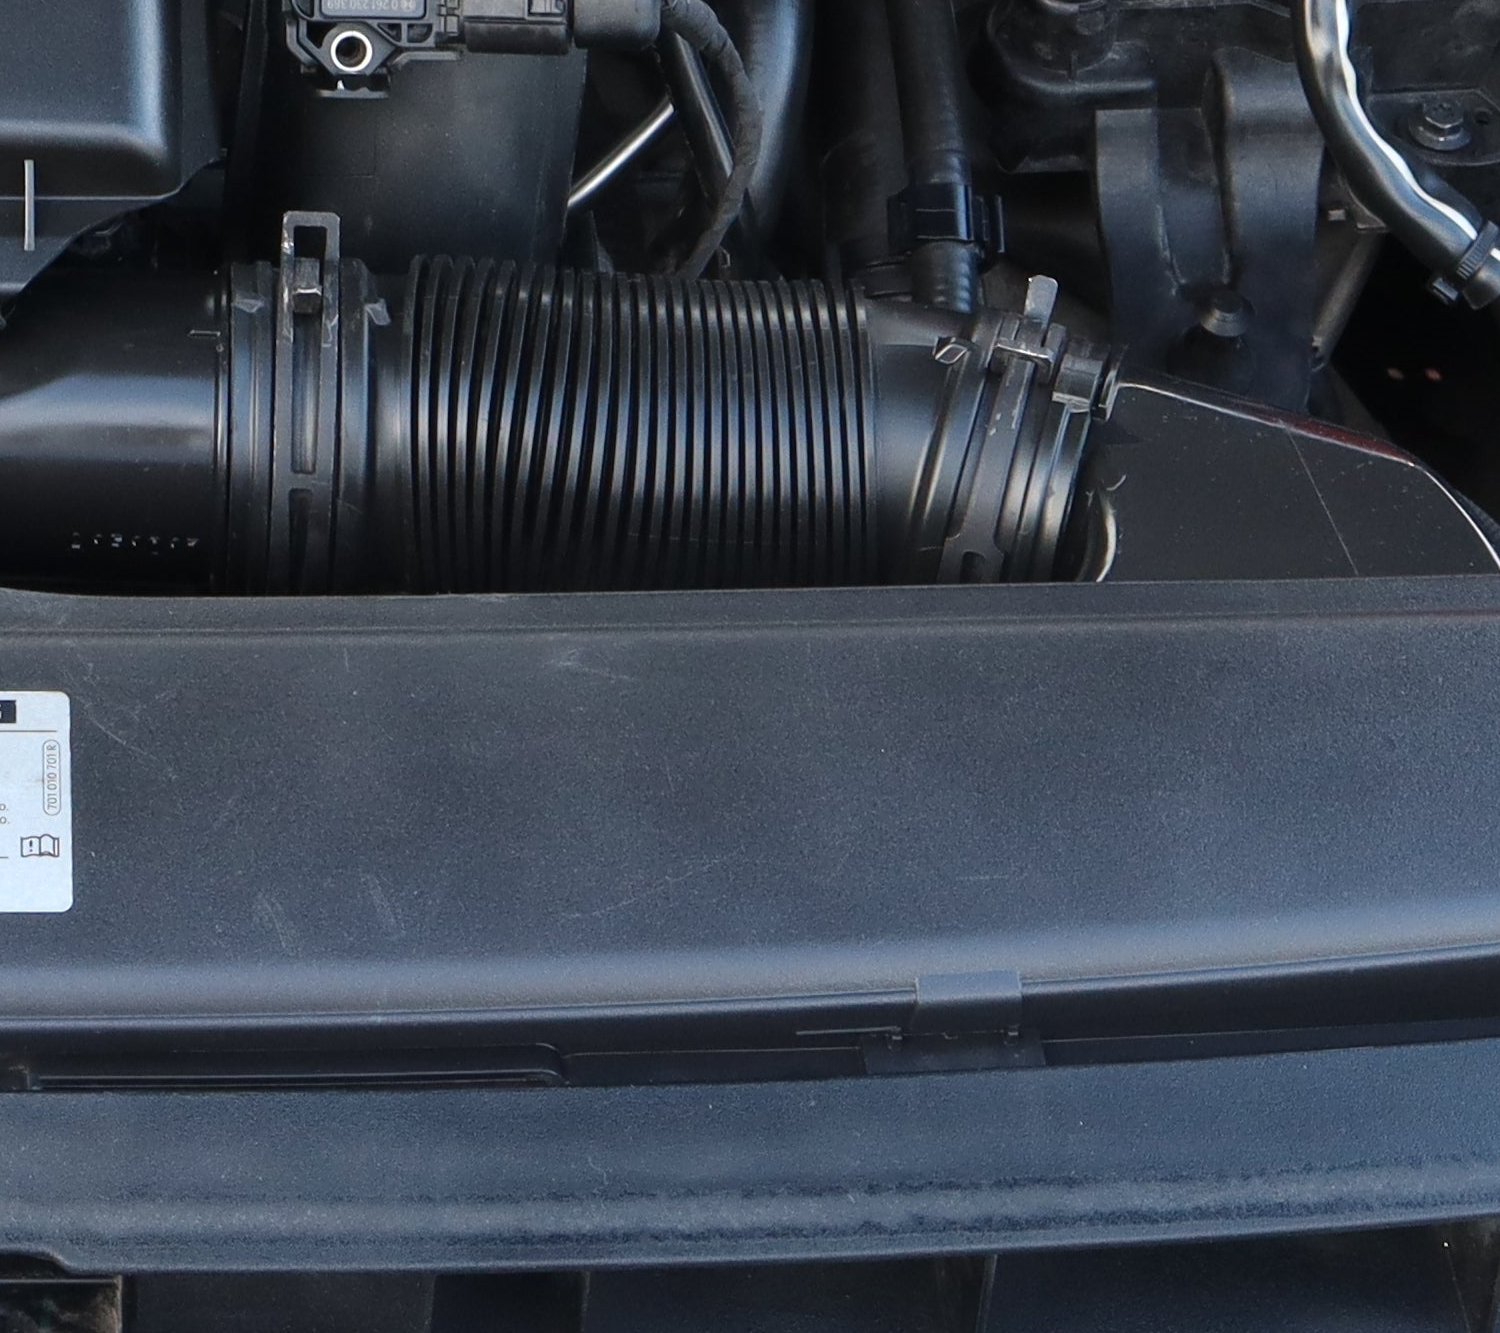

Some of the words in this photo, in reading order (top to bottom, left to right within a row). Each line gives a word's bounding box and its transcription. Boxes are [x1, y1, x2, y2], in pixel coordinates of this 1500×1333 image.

[391, 0, 398, 9] 0
[47, 744, 58, 752] R
[47, 753, 58, 771] 701
[47, 772, 58, 790] 010
[47, 792, 58, 810] 701
